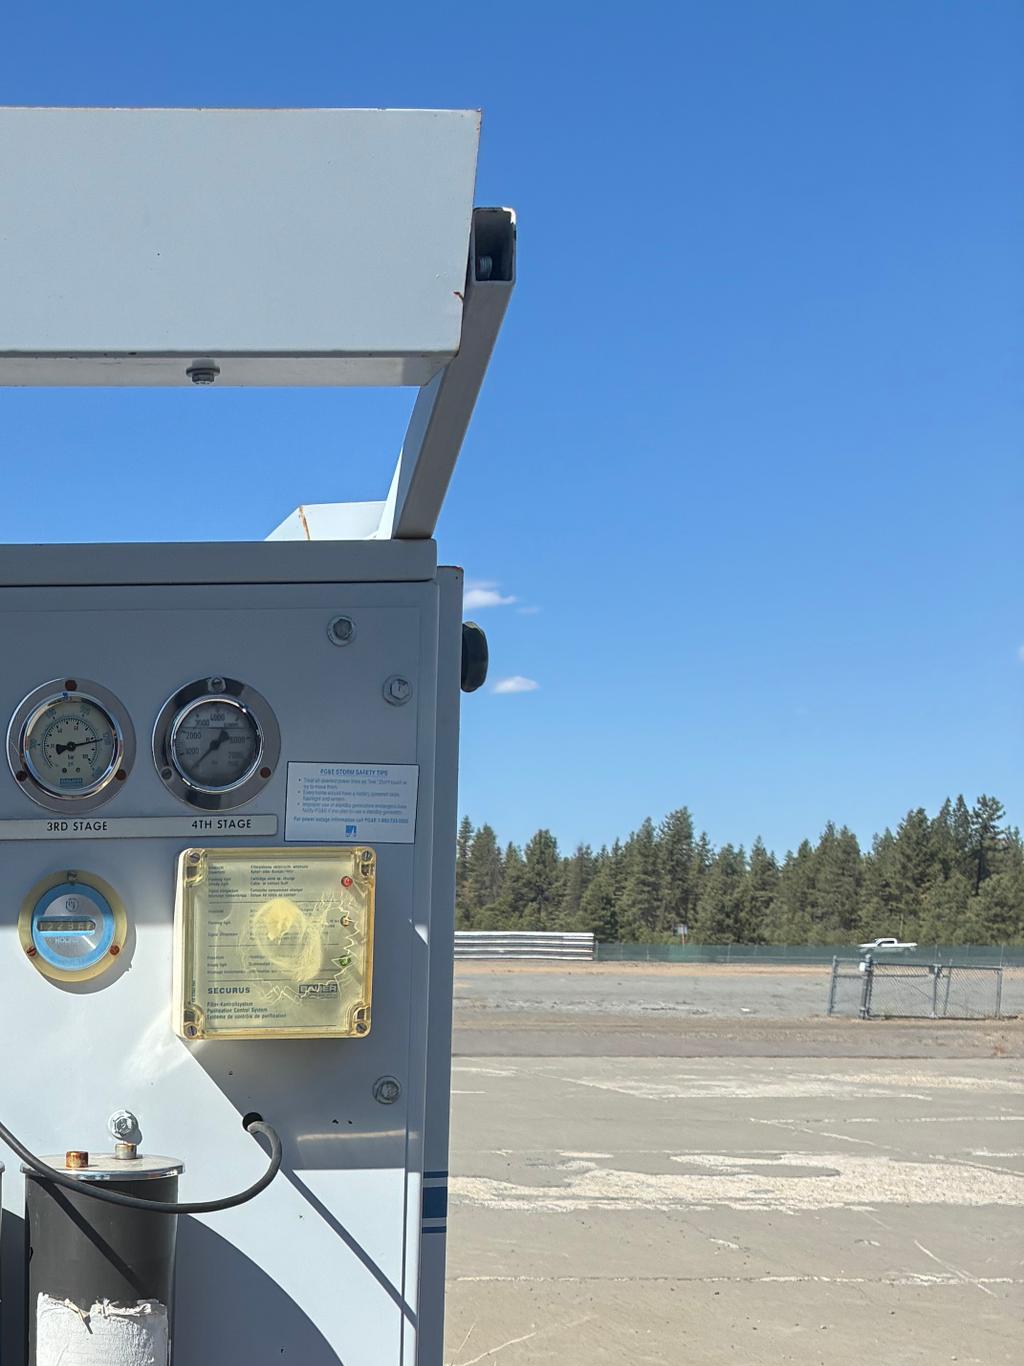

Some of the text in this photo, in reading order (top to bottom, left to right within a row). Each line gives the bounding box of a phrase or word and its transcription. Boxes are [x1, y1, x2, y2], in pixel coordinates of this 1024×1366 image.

[46, 821, 108, 832] 3RD STAGE
[191, 819, 252, 830] 4TH STAGE
